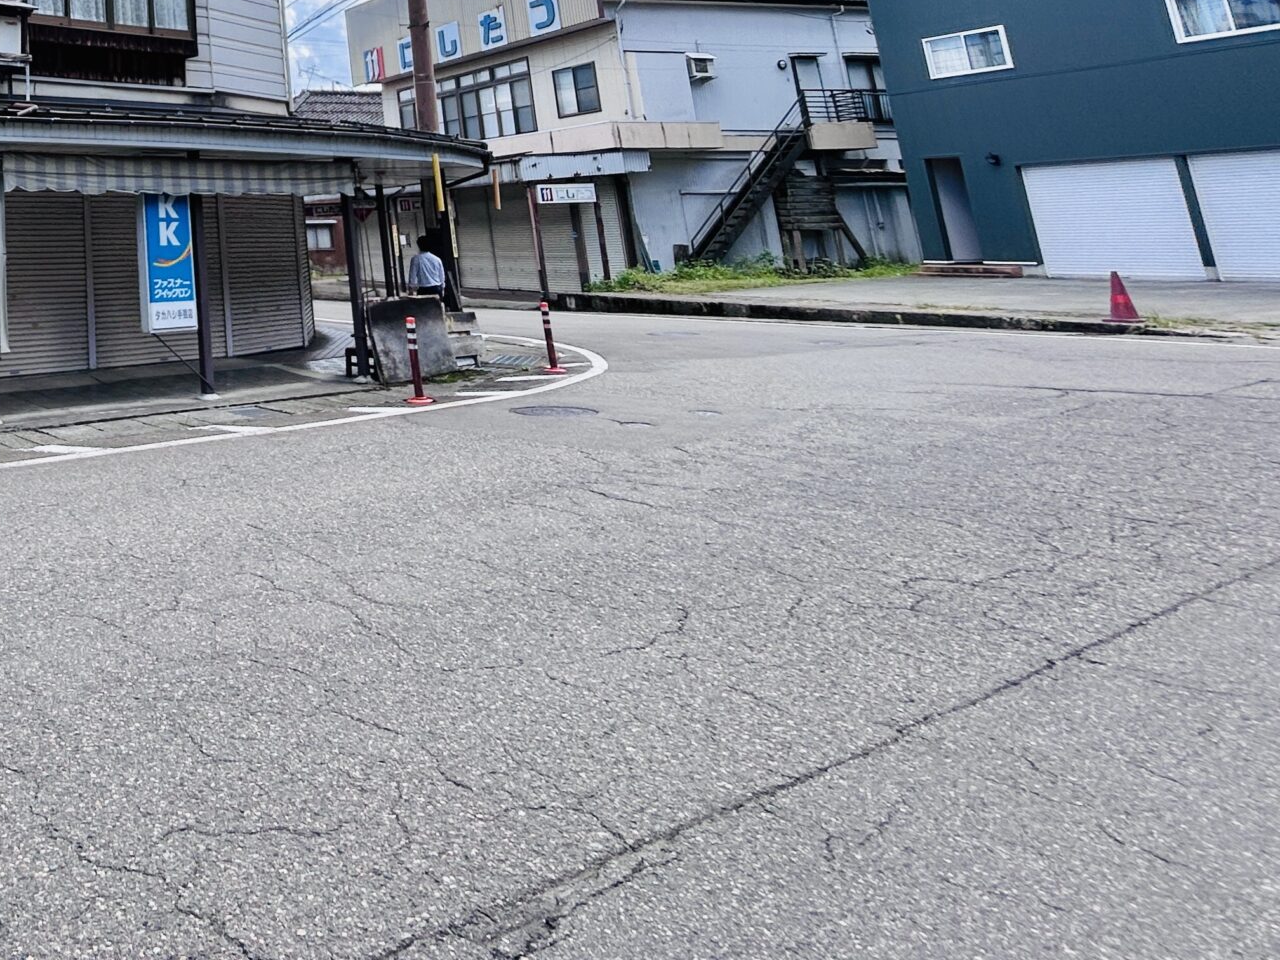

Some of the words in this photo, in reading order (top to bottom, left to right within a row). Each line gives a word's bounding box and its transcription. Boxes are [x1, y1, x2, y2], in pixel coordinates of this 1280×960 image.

[153, 278, 191, 289] ファスナー
[154, 287, 192, 299] クイックロン
